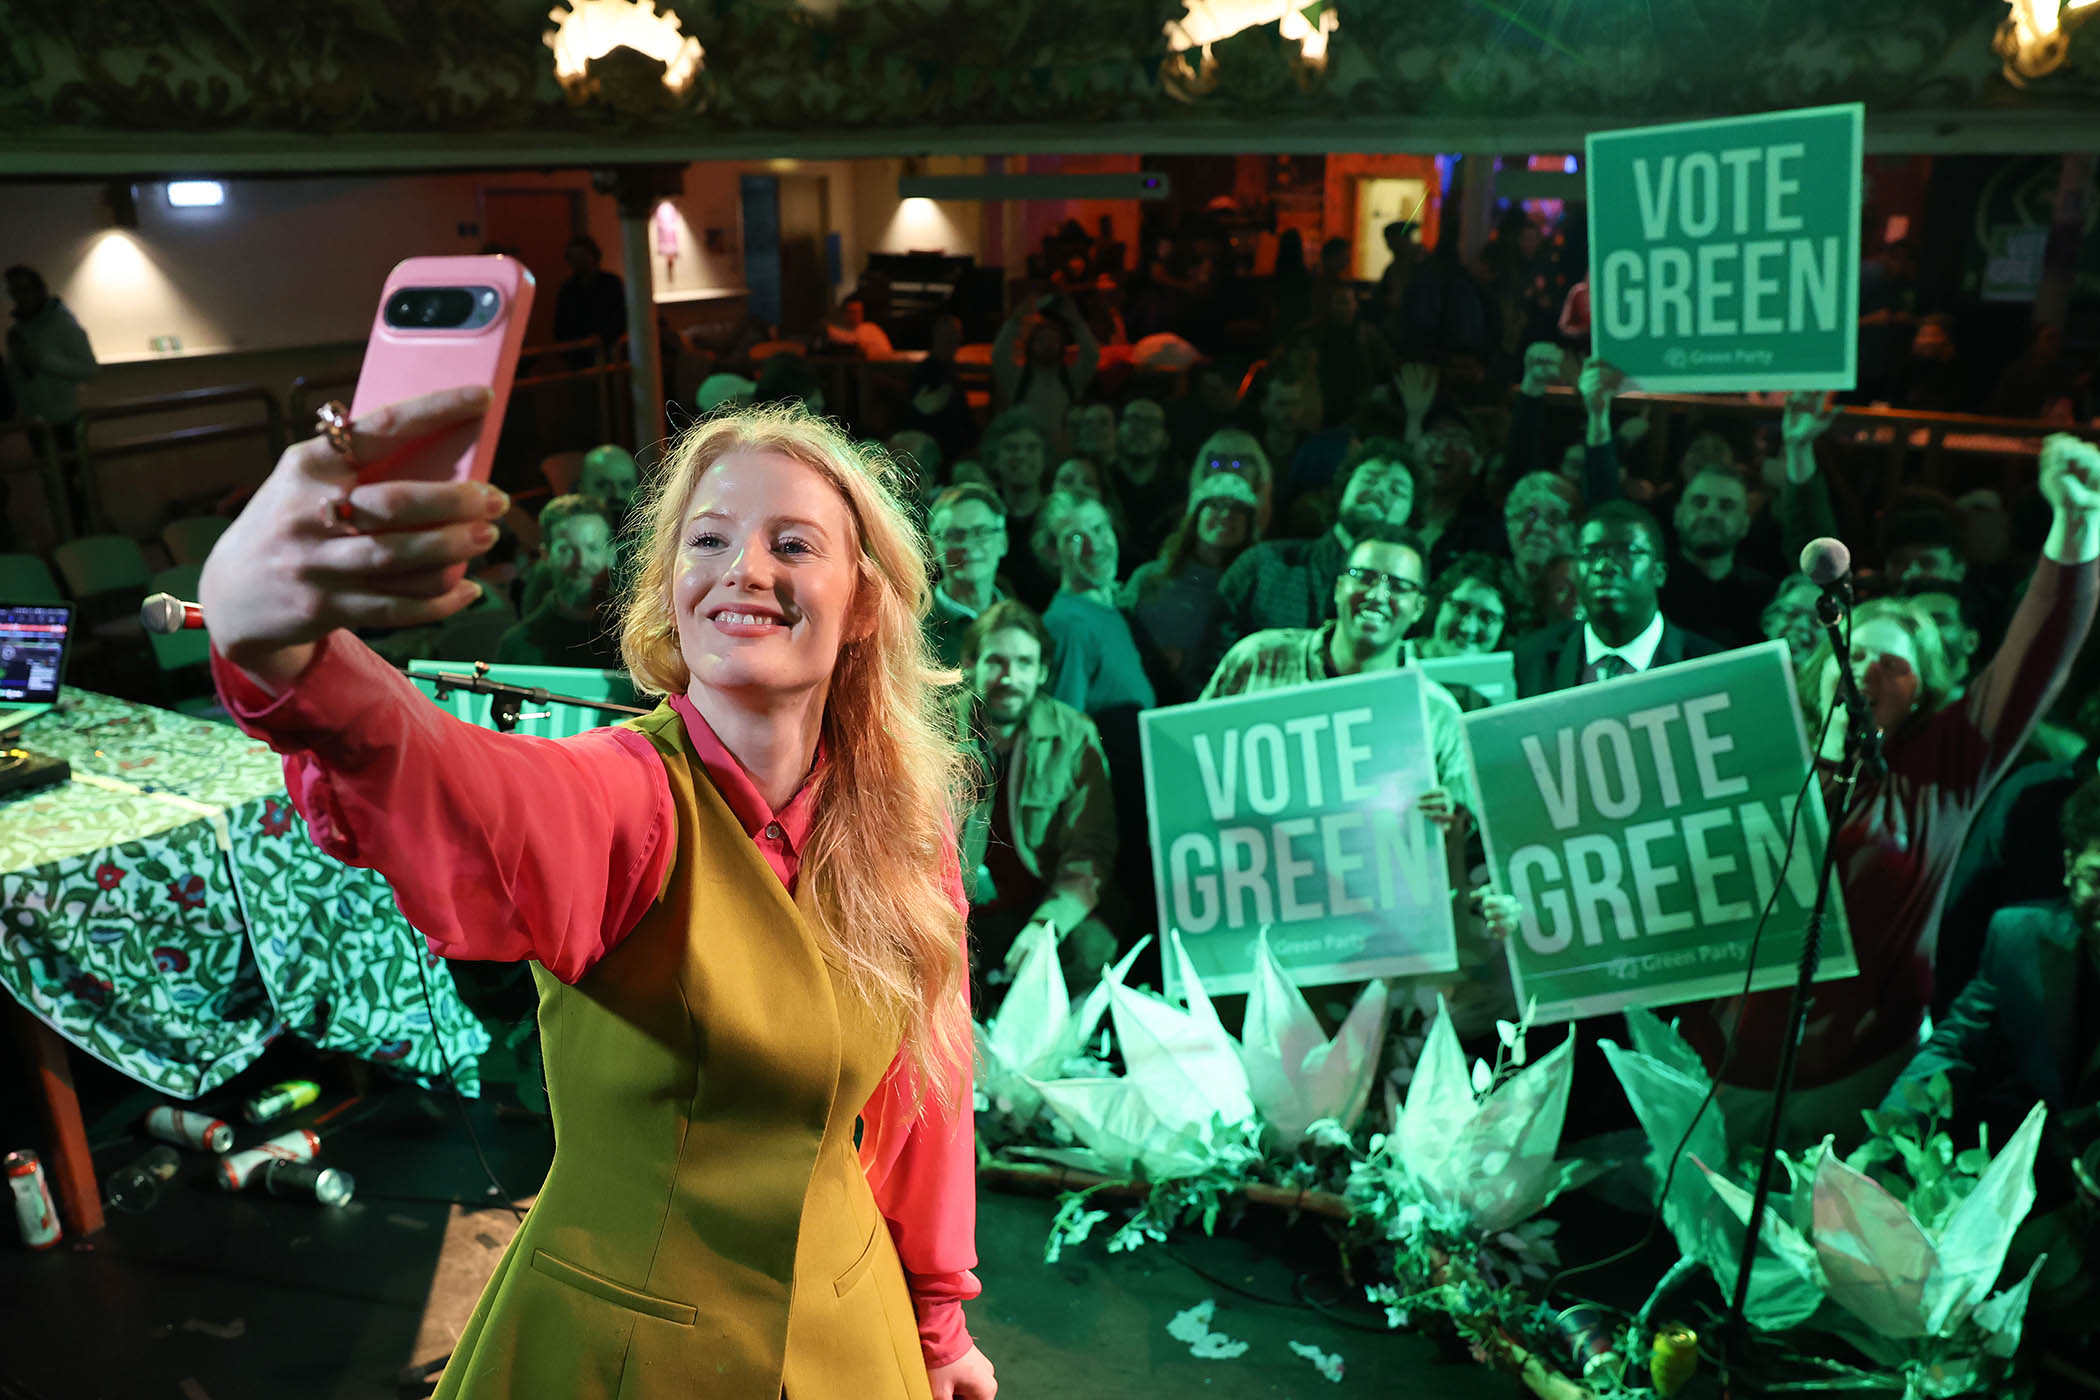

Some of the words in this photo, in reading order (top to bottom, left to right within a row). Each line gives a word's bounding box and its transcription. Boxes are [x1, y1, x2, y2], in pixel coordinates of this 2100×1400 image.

[1632, 142, 1805, 241] VOTE
[1603, 236, 1840, 340] GREEN
[1193, 707, 1378, 821] VOTE
[1521, 692, 1749, 830] VOTE
[1169, 806, 1433, 934] GREEN
[1508, 794, 1820, 956] GREEN
[1640, 953, 1697, 972] Green
[1699, 941, 1748, 962] Party
